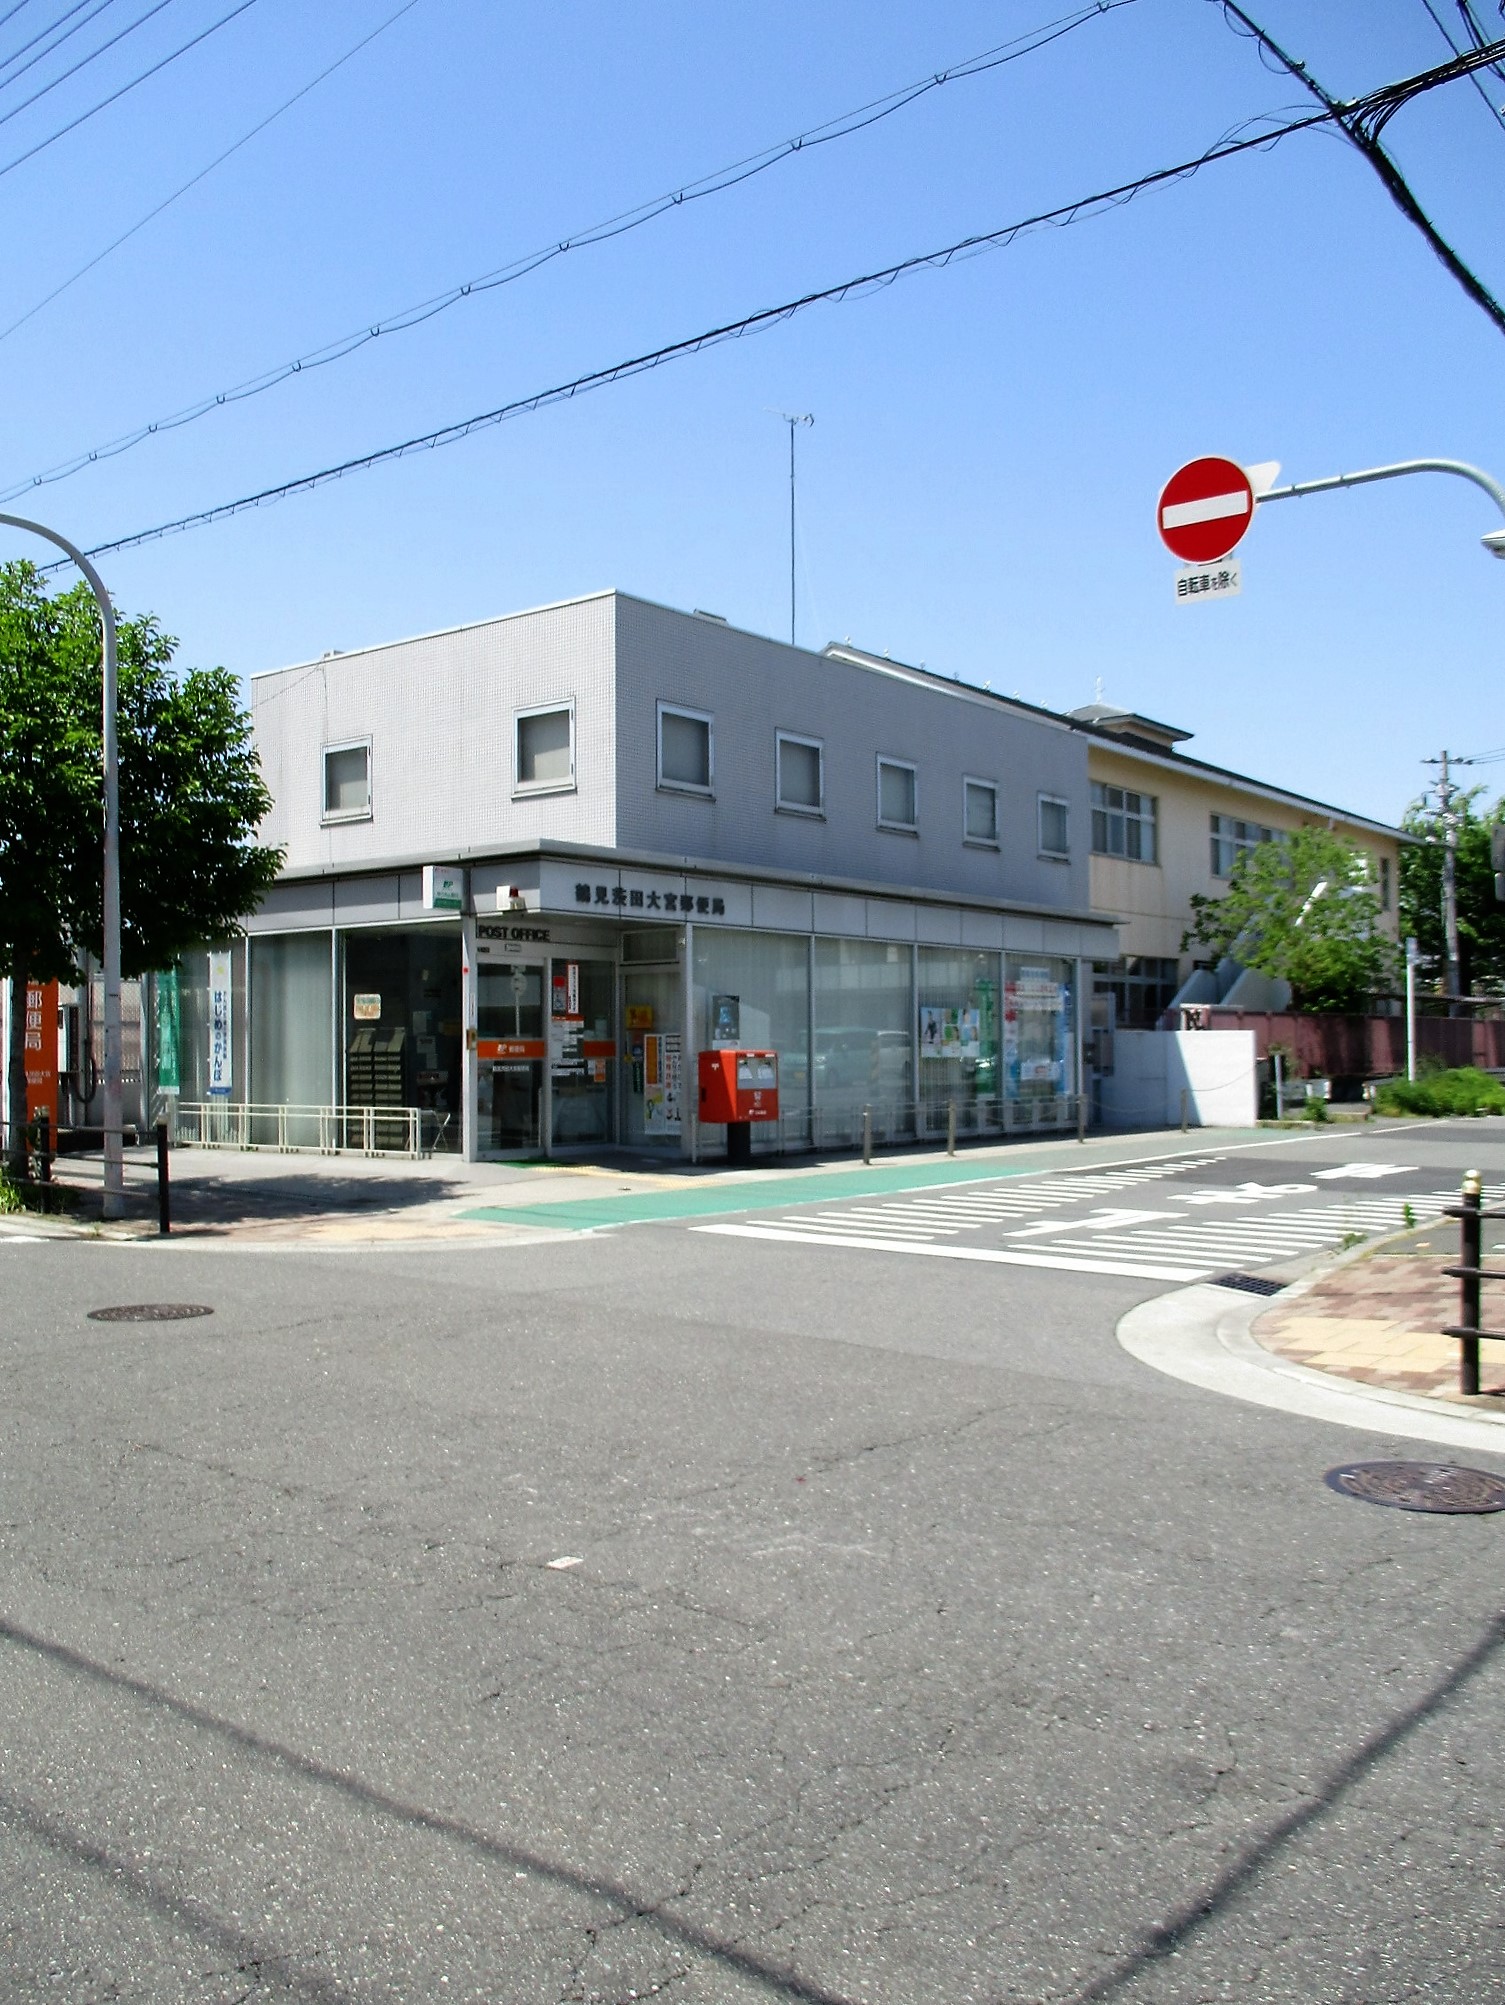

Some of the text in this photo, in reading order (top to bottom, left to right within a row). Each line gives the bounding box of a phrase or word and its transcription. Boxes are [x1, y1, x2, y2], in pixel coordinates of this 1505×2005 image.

[1177, 570, 1238, 597] 自転車を除く
[478, 924, 550, 942] POST OFFICE
[25, 990, 42, 1051] 郵便局
